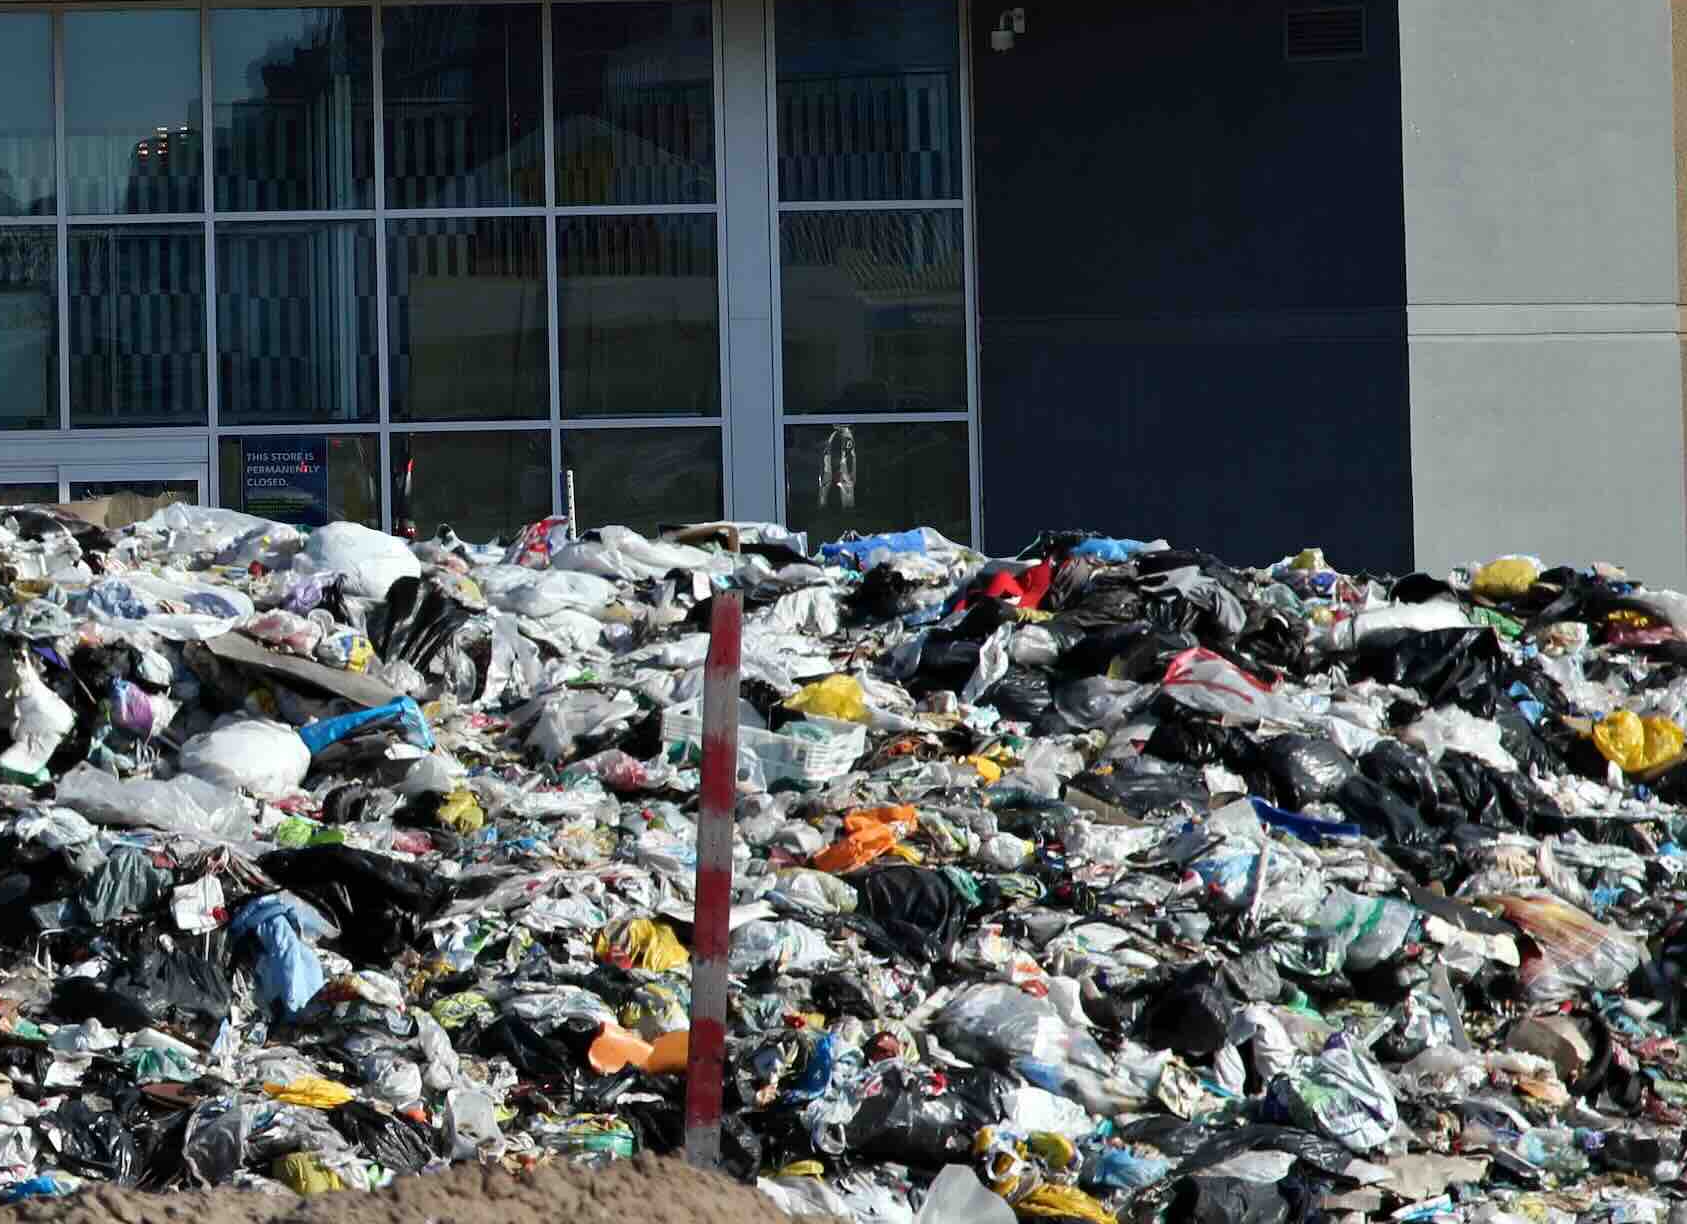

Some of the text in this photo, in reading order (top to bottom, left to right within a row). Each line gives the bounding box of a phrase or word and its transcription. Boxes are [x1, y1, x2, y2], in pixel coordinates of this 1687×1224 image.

[247, 452, 313, 462] THIS STORE IS
[247, 465, 321, 474] PERMANENTLY
[247, 477, 289, 487] CLOSED.
